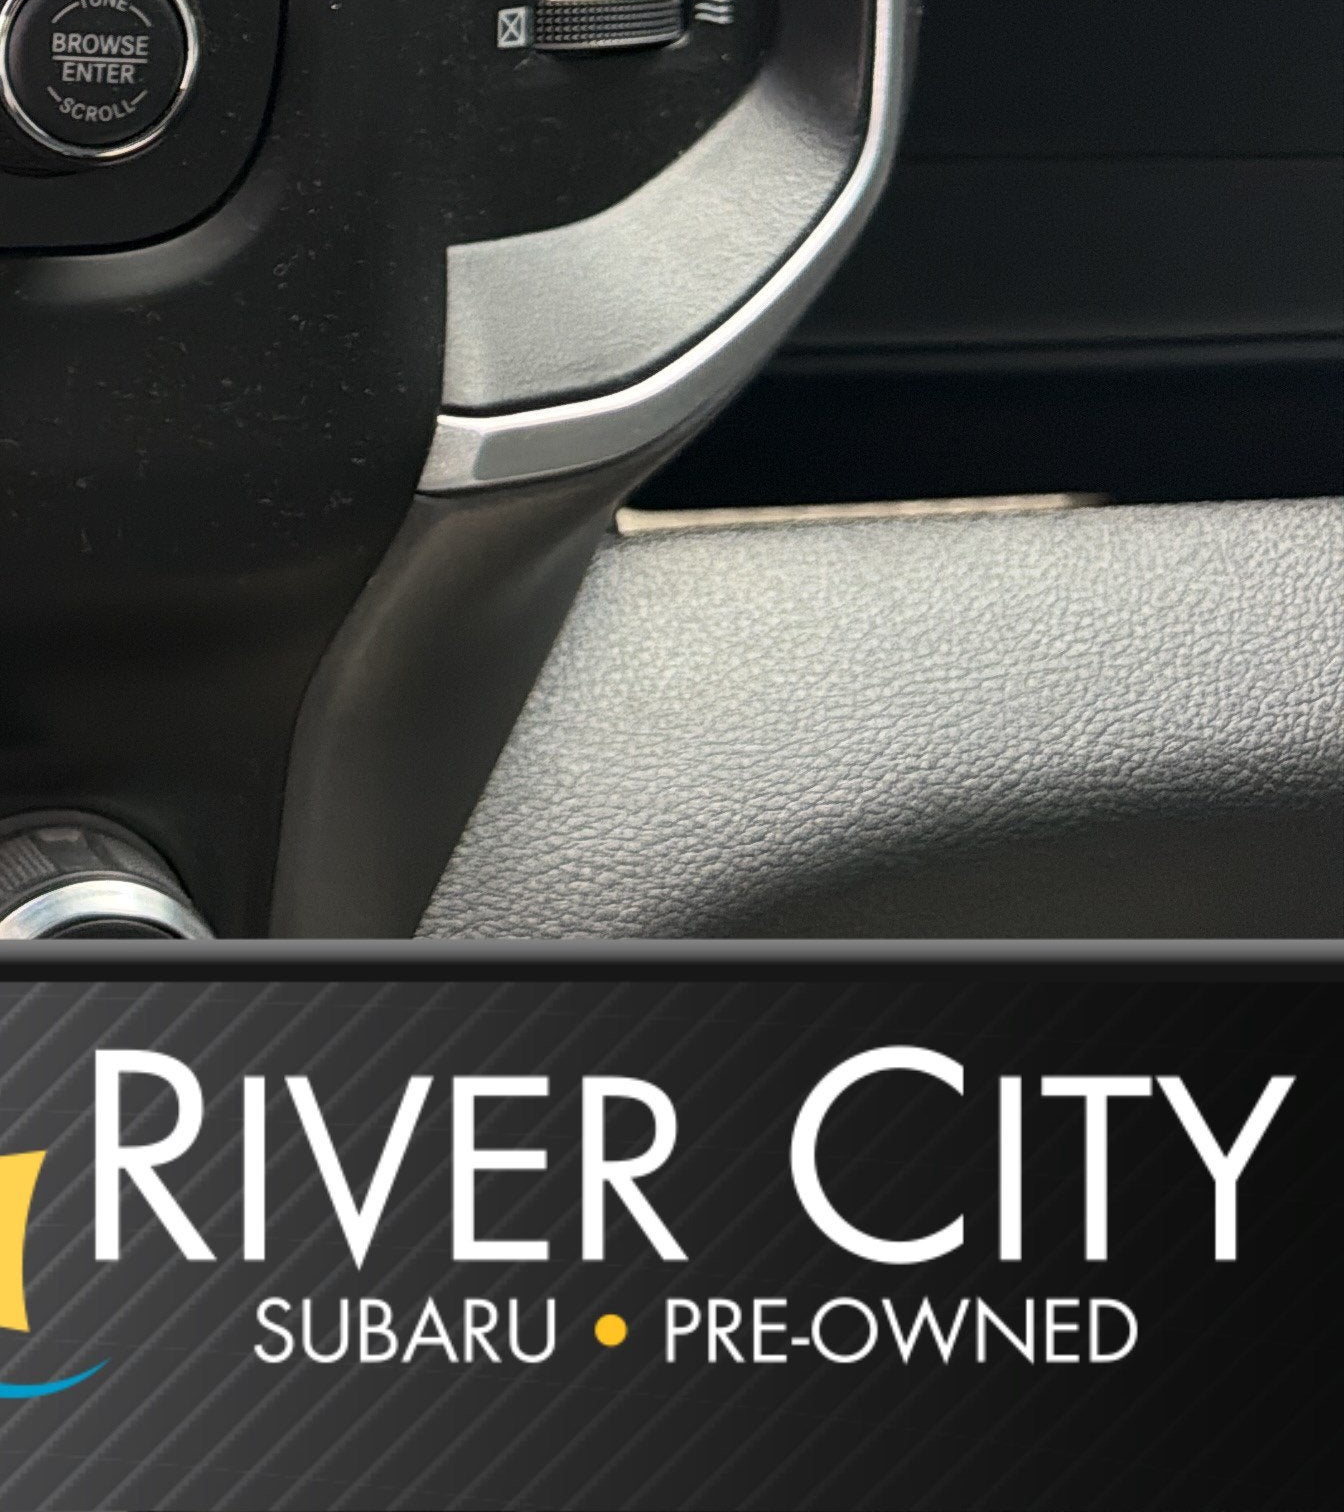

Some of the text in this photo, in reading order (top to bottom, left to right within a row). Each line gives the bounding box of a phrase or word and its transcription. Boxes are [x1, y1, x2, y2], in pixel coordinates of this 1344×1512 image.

[51, 32, 149, 57] BROWSE
[62, 61, 136, 84] ENTER
[57, 96, 136, 123] SCROLL
